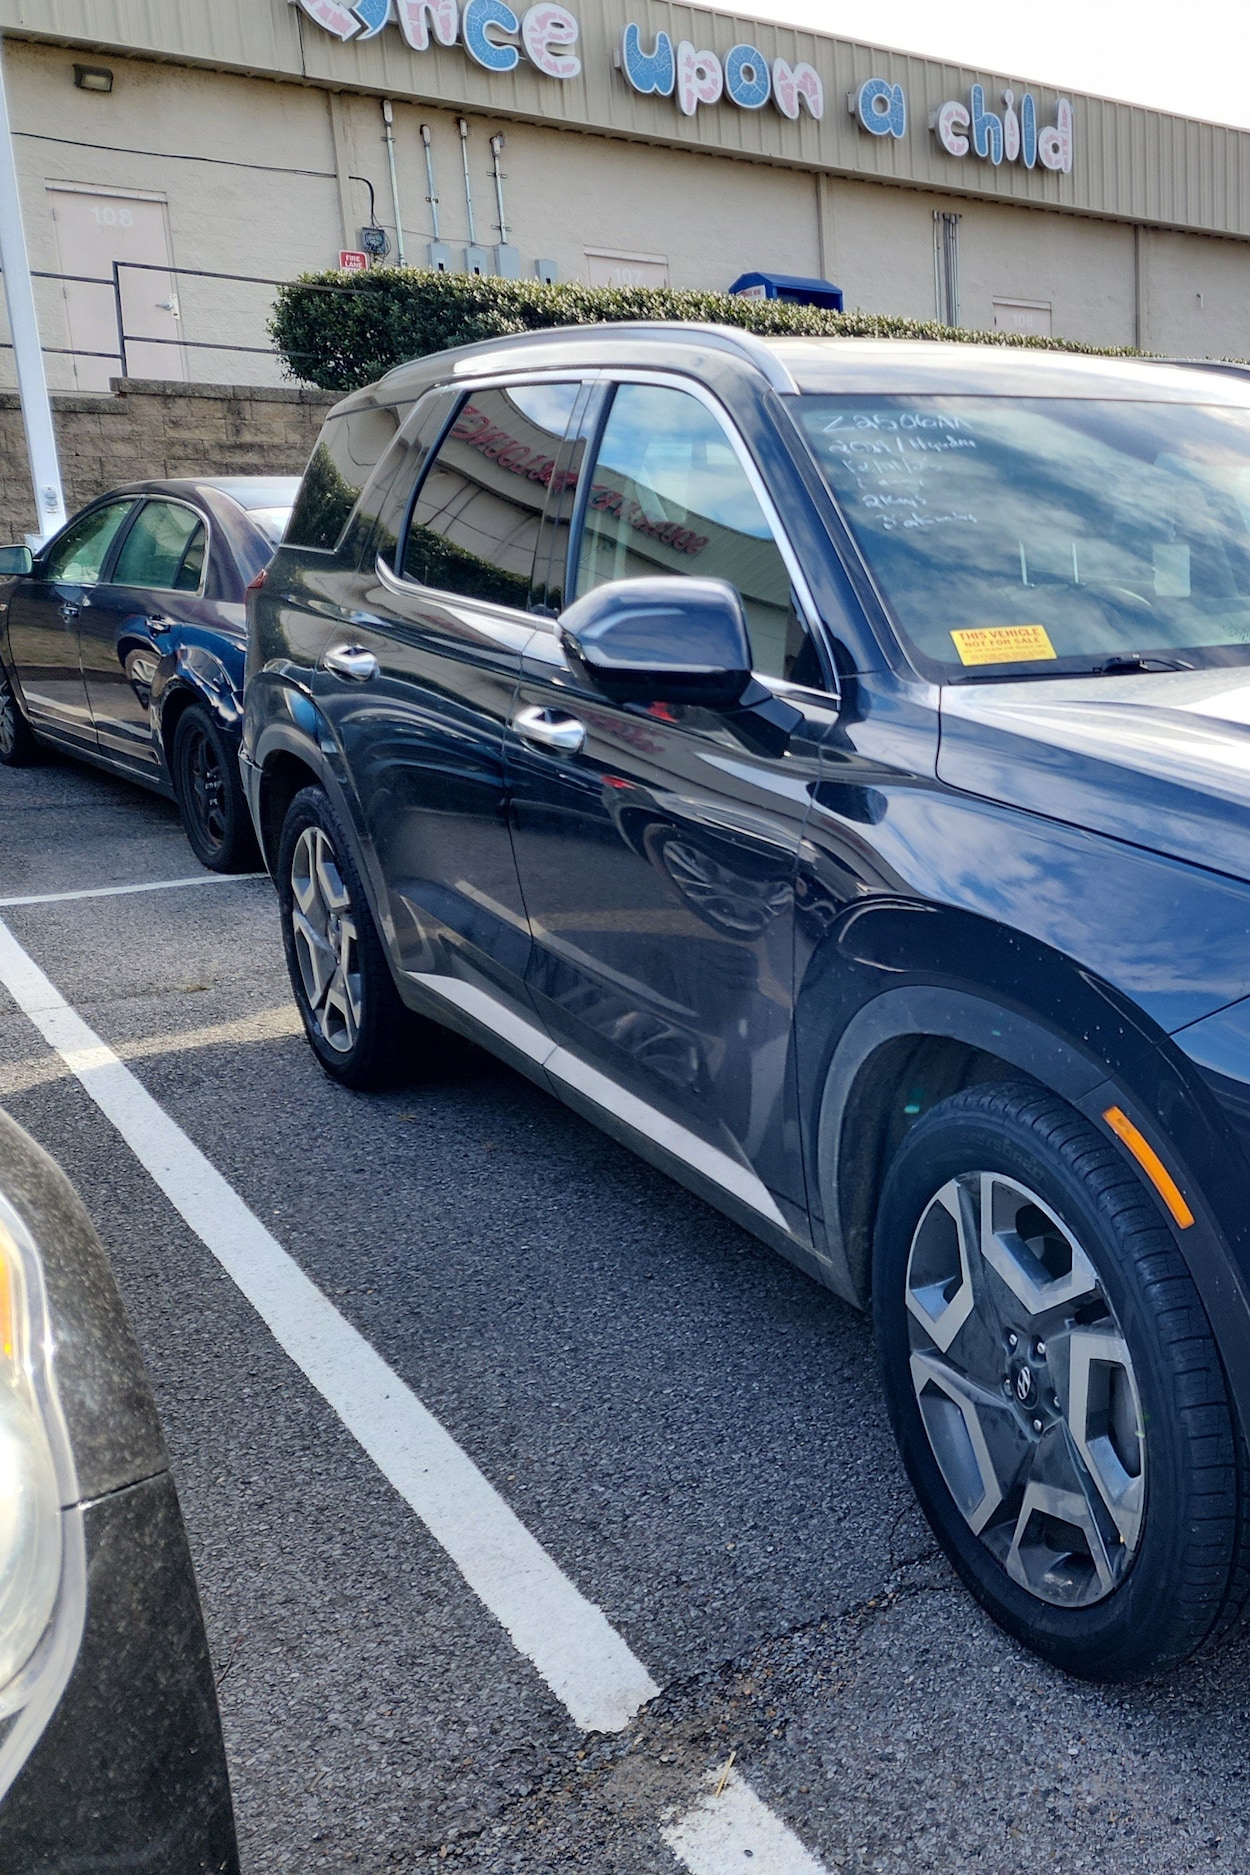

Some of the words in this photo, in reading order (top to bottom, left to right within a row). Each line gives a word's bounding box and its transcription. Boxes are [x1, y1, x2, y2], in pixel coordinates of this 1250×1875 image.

[622, 22, 824, 120] upon
[857, 77, 906, 139] a
[937, 83, 1074, 174] child
[90, 206, 134, 226] 108
[344, 260, 363, 268] LANE
[345, 254, 361, 262] FIRE
[958, 630, 988, 641] THIS
[988, 627, 1041, 639] VEHICLE
[964, 639, 986, 648] NOT
[989, 638, 1011, 646] FOR
